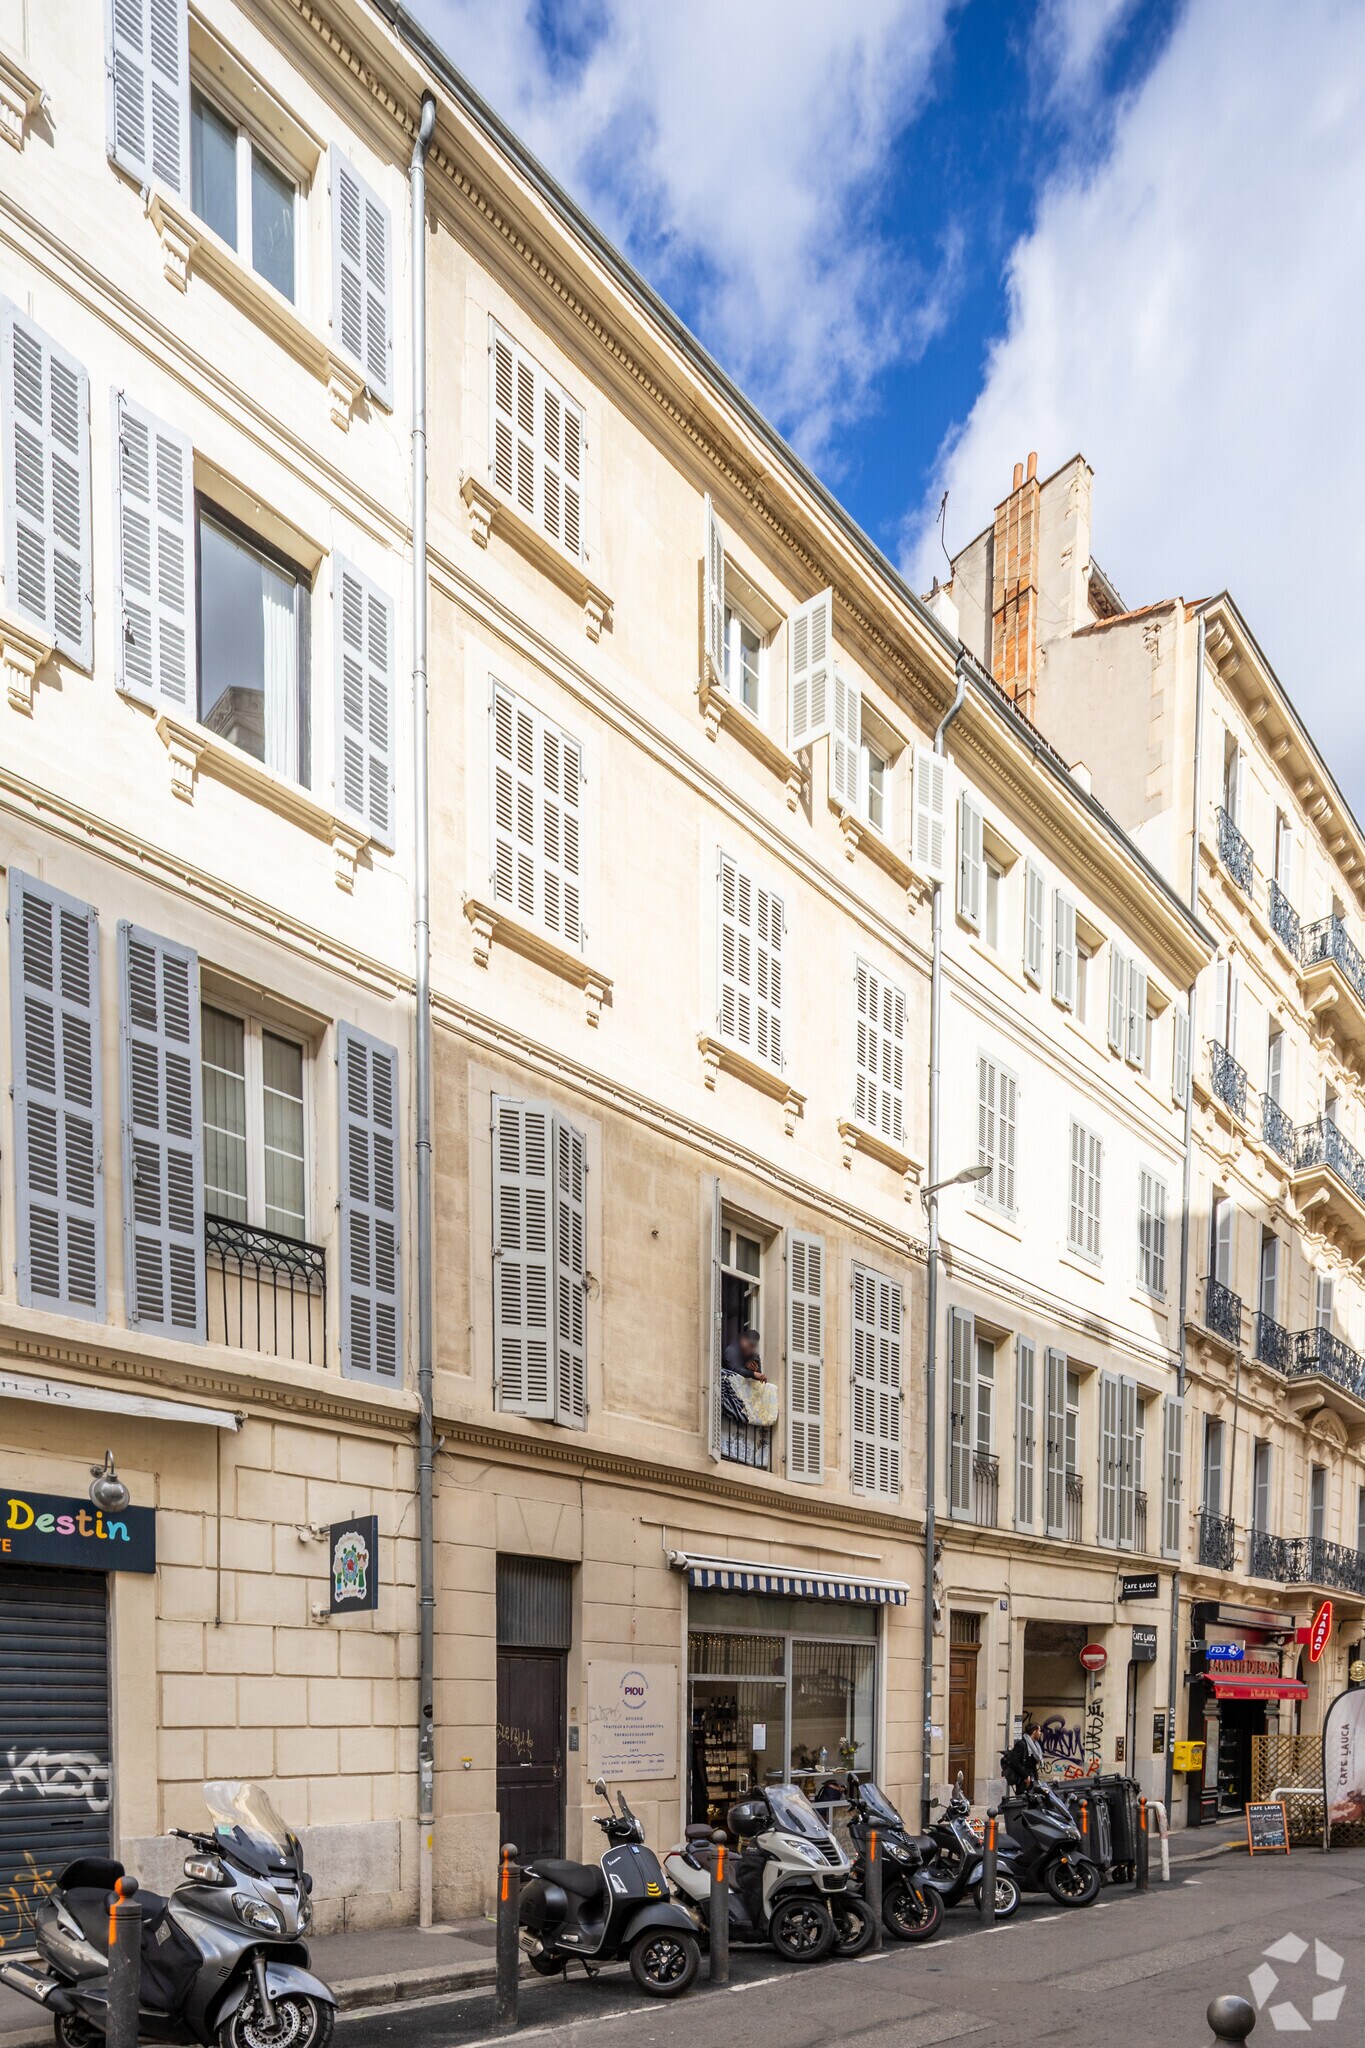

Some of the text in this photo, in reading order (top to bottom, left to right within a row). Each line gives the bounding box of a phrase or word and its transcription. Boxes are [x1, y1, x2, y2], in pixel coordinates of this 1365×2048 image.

[6, 1498, 131, 1542] Destin
[1123, 1582, 1157, 1590] CAFE LAUCA
[1132, 1632, 1156, 1642] CAFE LAUCA
[1313, 1613, 1329, 1651] TABAC
[1210, 1646, 1226, 1654] FDJ
[624, 1686, 644, 1696] PIOU
[1340, 1723, 1350, 1786] CAFE LAUCA
